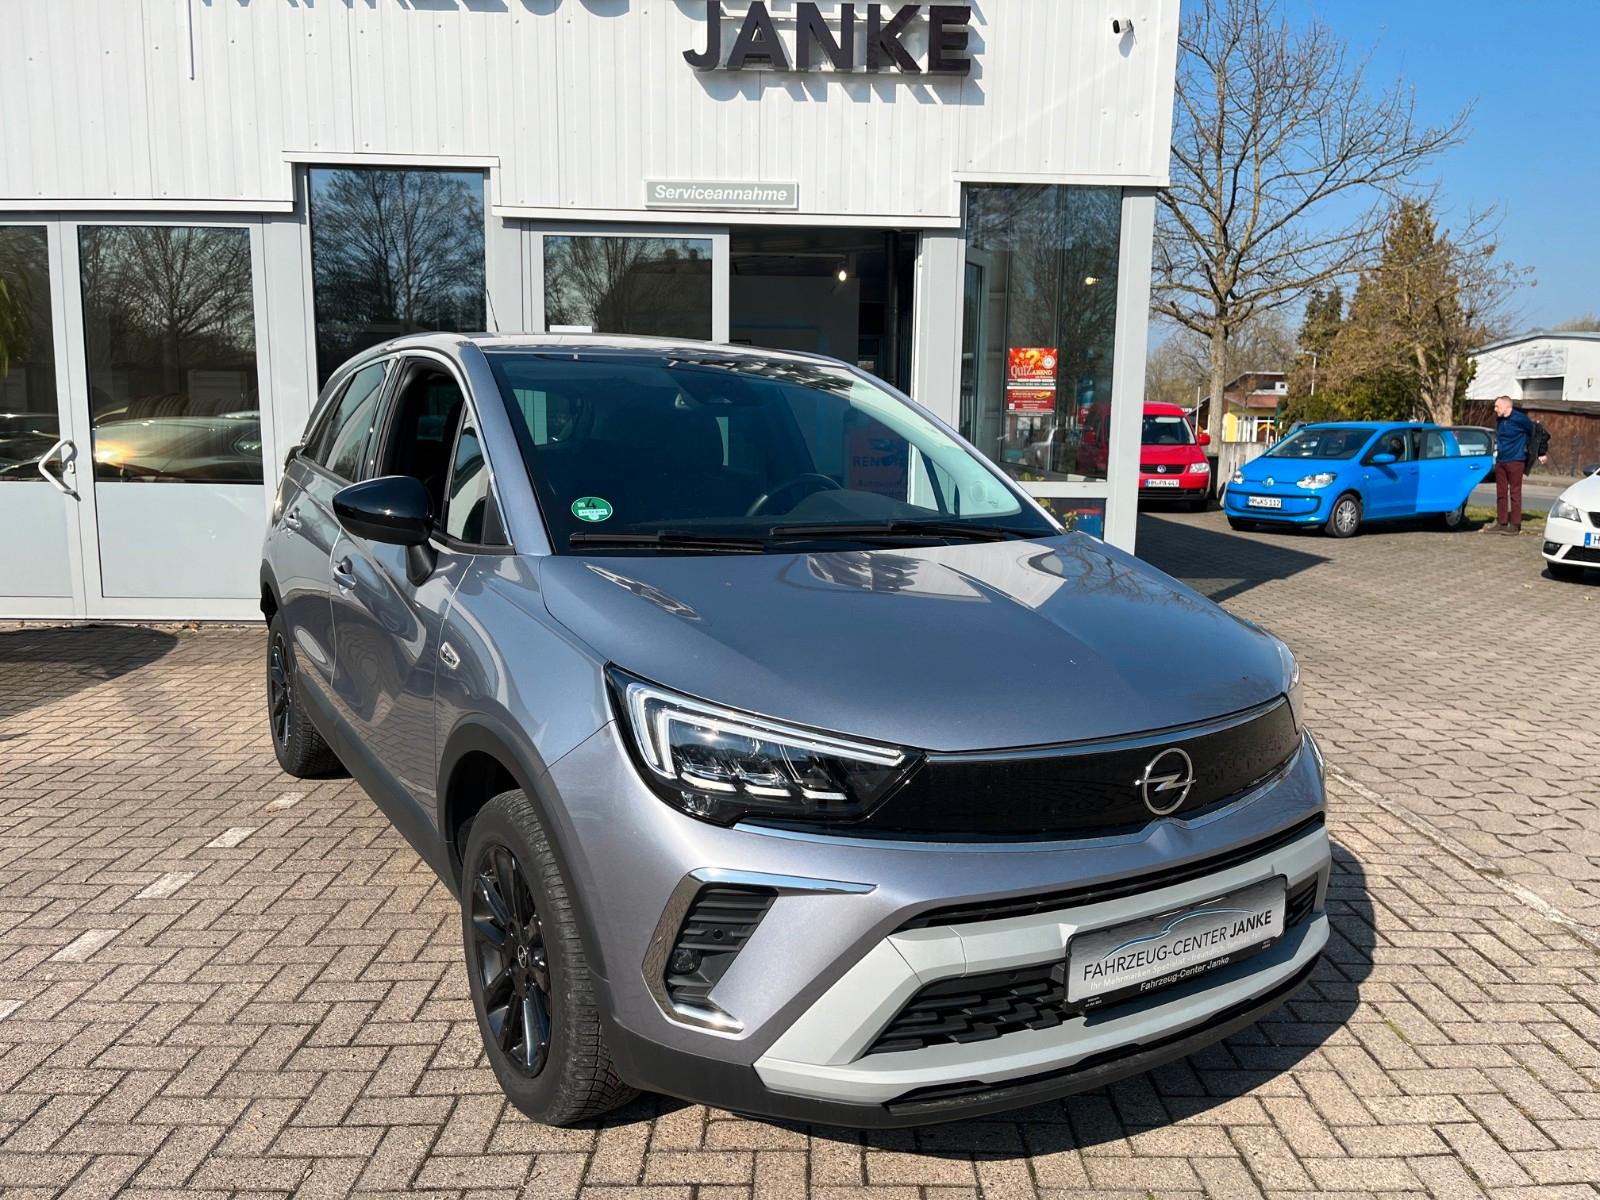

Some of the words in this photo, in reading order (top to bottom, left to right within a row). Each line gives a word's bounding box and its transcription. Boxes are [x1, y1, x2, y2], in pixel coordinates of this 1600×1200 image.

[682, 0, 971, 76] JANKE
[654, 184, 788, 202] Serviceannahme
[1083, 926, 1227, 981] FAHRZEUG-CENTER
[1229, 909, 1272, 938] JANKE
[1140, 963, 1206, 992] Fahrzeug-Center
[1206, 956, 1230, 971] Janke
